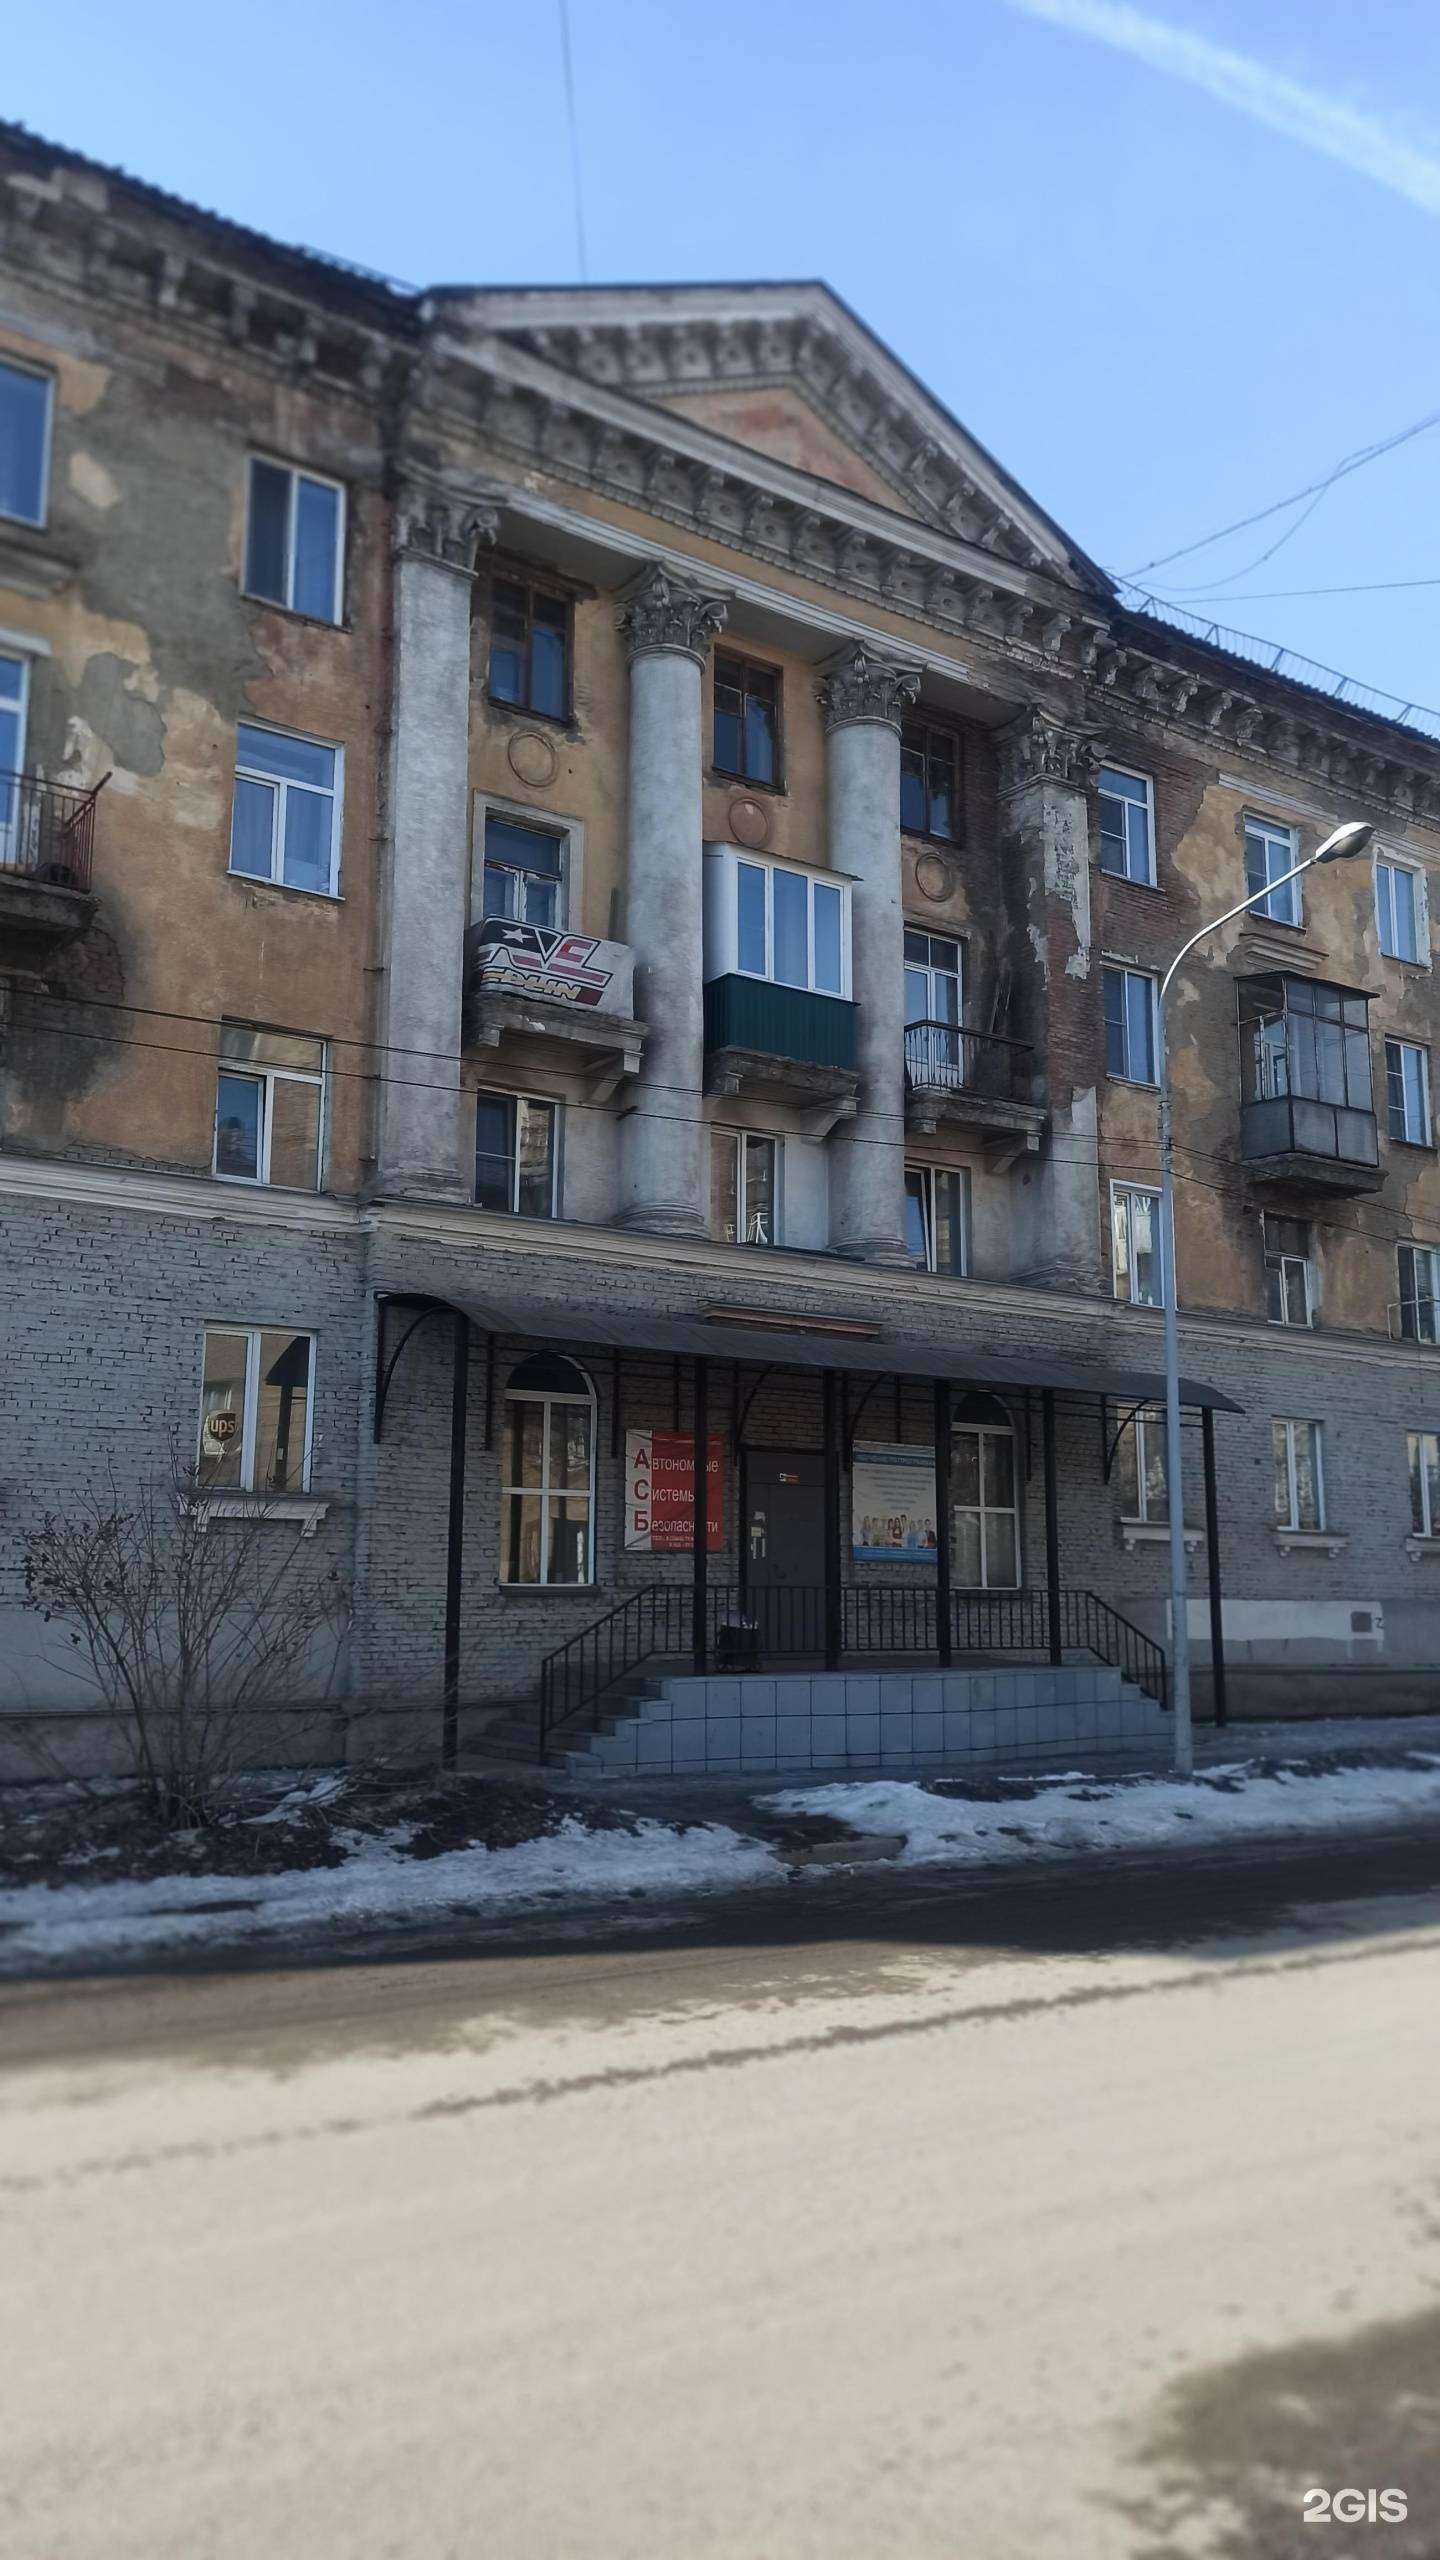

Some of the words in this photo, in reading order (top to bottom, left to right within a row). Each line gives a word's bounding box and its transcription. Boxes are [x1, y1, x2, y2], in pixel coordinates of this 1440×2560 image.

[210, 1419, 235, 1438] ups
[633, 1448, 720, 1472] Автономе
[633, 1510, 719, 1533] Безопаснти
